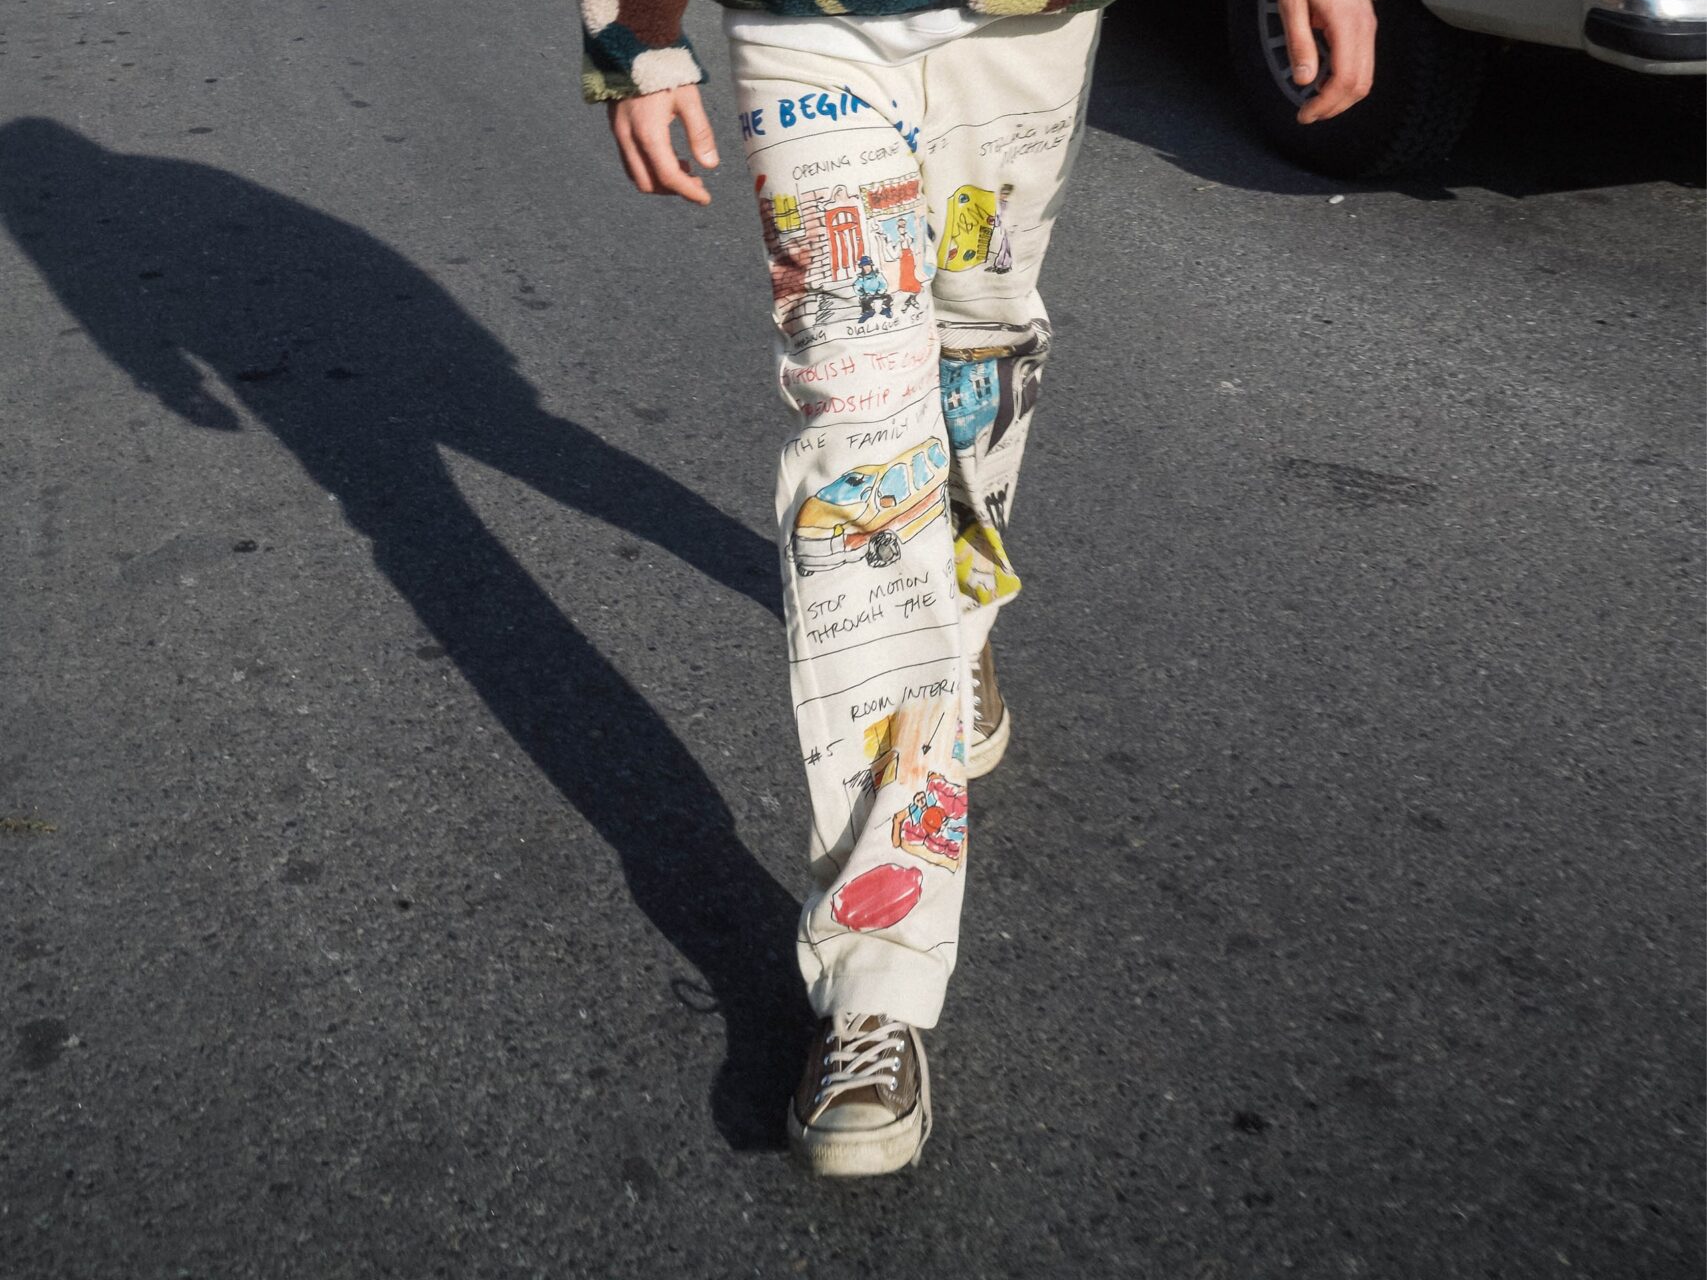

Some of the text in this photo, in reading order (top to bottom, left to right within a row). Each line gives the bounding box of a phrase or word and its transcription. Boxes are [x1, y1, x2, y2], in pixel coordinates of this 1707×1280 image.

[792, 154, 851, 181] OPENING
[785, 432, 827, 457] THE
[807, 571, 930, 620] STOP MOTION
[806, 591, 937, 644] THROUGH THE
[850, 696, 895, 723] ROOM
